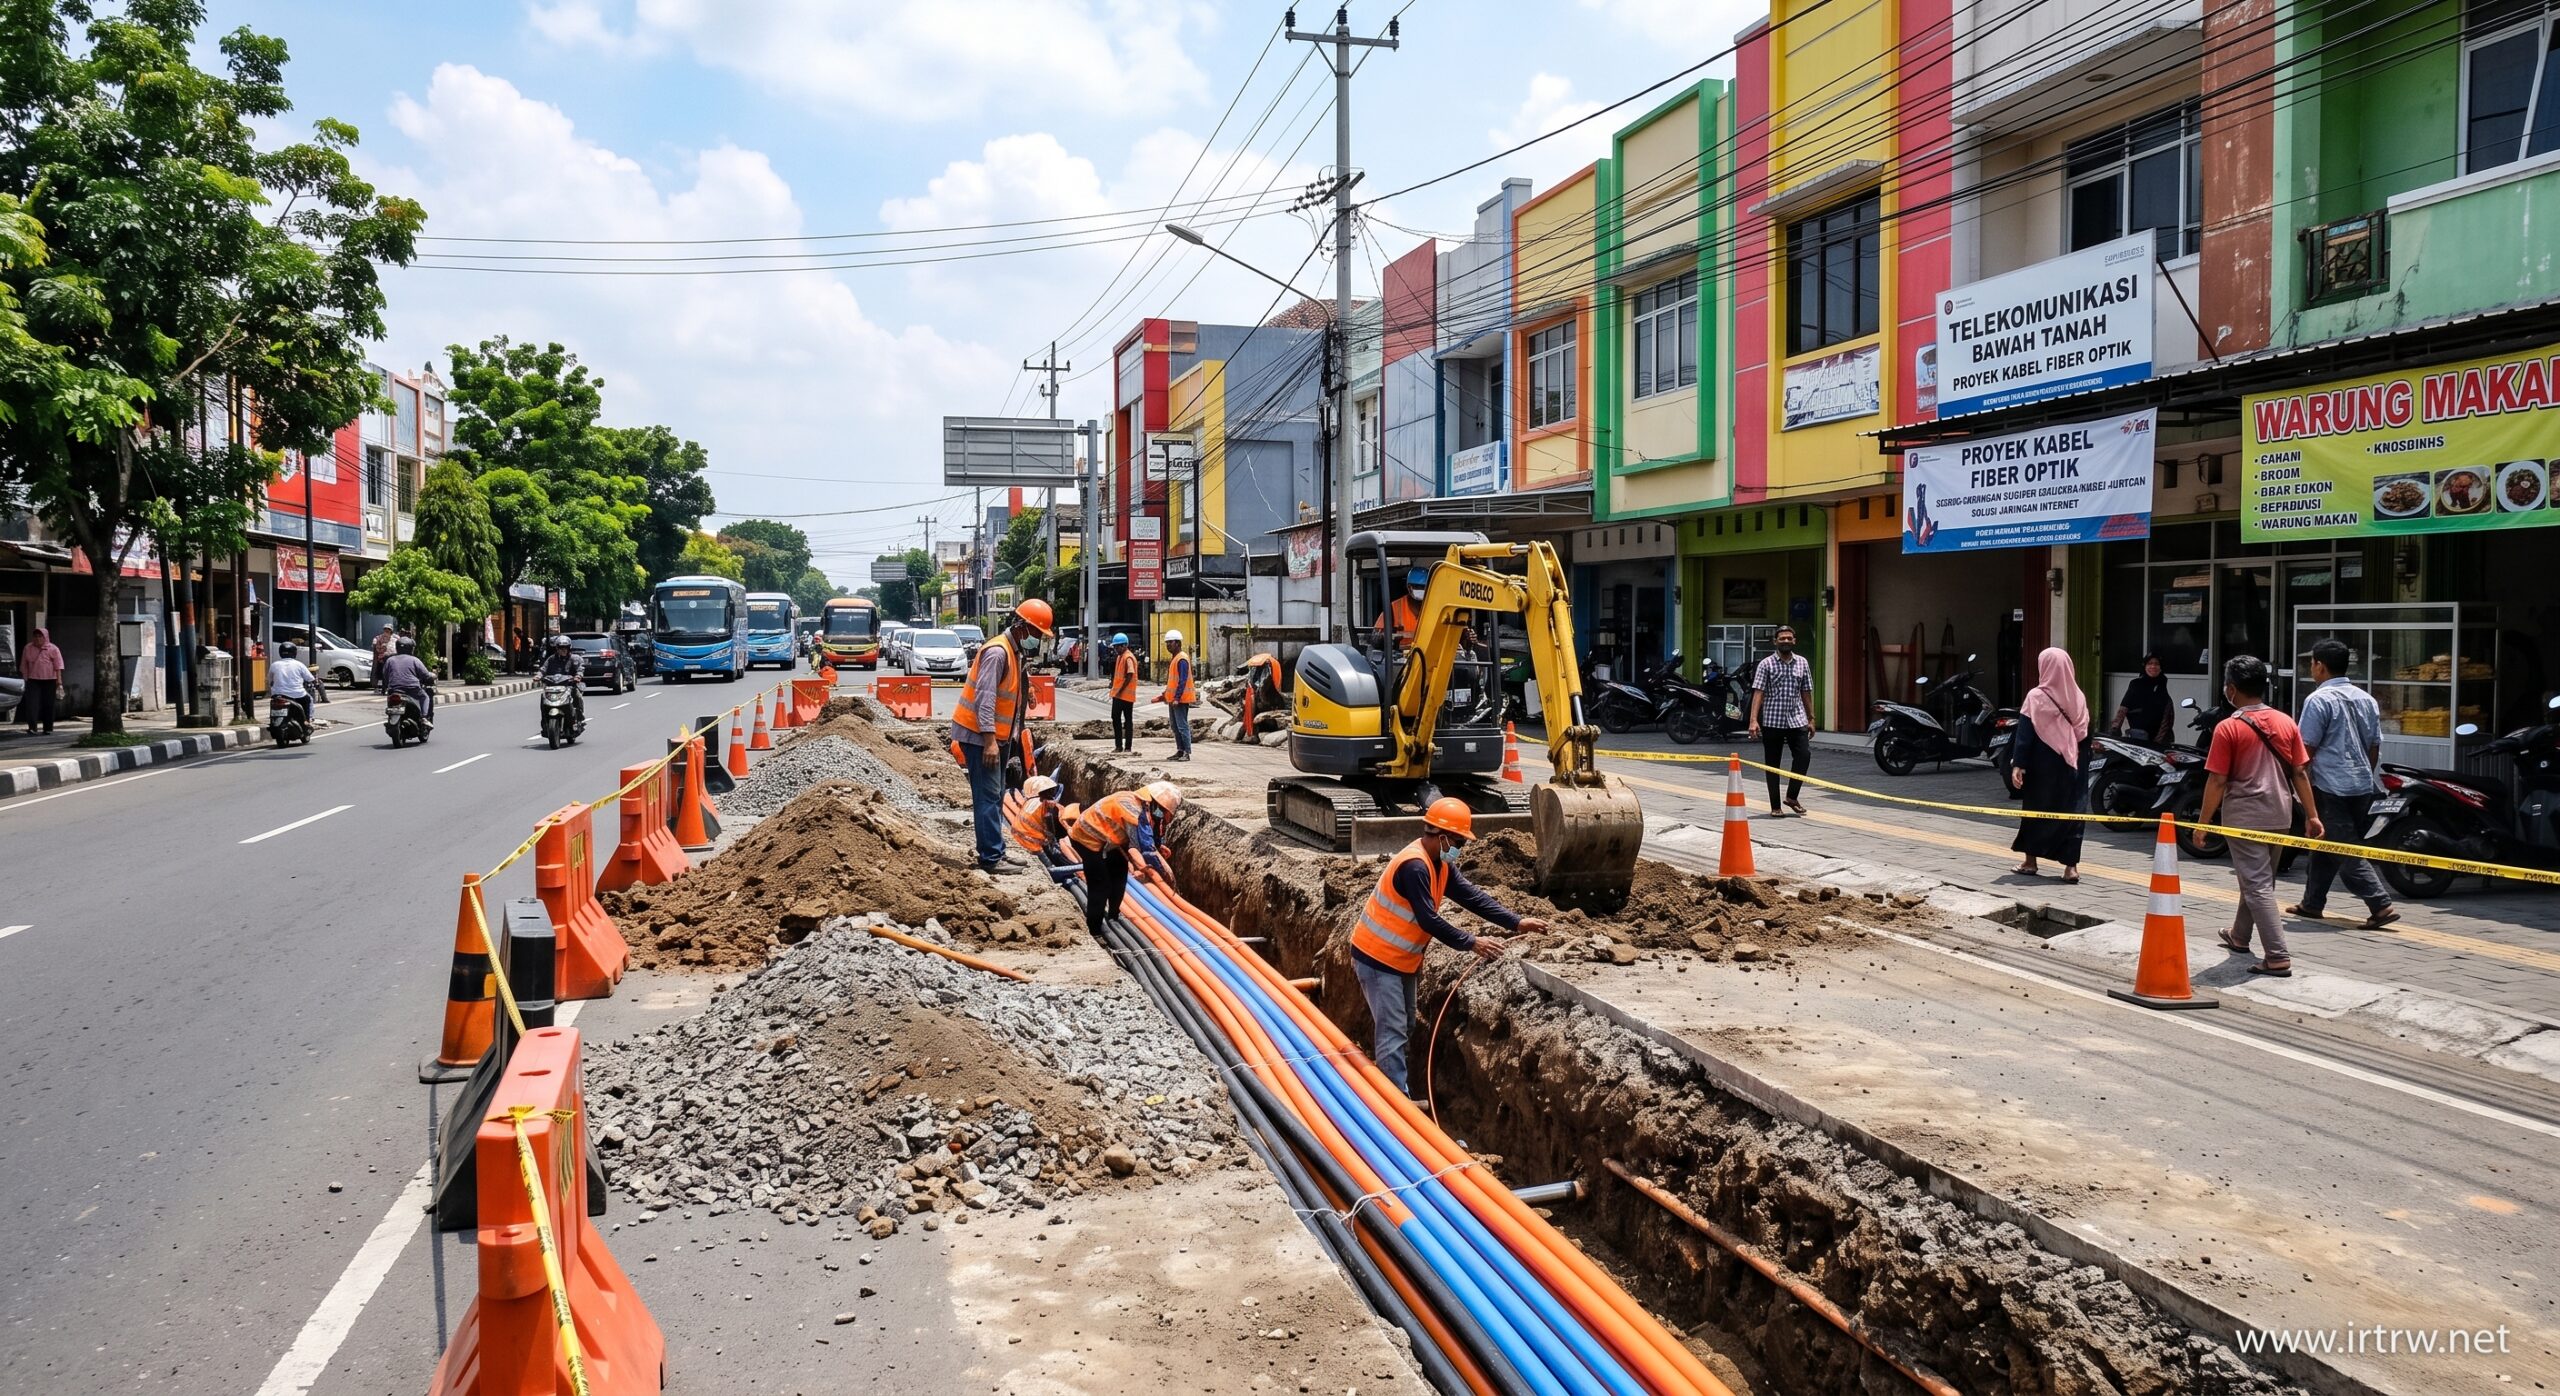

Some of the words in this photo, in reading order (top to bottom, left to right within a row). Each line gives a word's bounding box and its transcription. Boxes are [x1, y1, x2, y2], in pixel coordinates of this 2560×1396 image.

[1949, 275, 2138, 344] TELEKOMUNIKASI
[1972, 332, 2035, 363] BAWAH
[2041, 314, 2107, 347] TANAH
[1953, 369, 1999, 391] PROYEK
[2002, 360, 2043, 380] KABEL
[2046, 351, 2084, 373] FIBER
[2089, 339, 2132, 362] OPTIK
[2253, 380, 2413, 444] WARUNG
[1961, 438, 2028, 466] PROYEK
[2033, 430, 2094, 455] KABEL
[1970, 466, 2019, 489] FIBER
[2024, 458, 2079, 482] OPTIK
[1971, 507, 1997, 518] SOLUSI
[1999, 503, 2038, 515] JARINGAN
[2040, 499, 2079, 511] INTERNET
[2261, 516, 2311, 530] WARUNG
[2314, 512, 2358, 527] MAKAN
